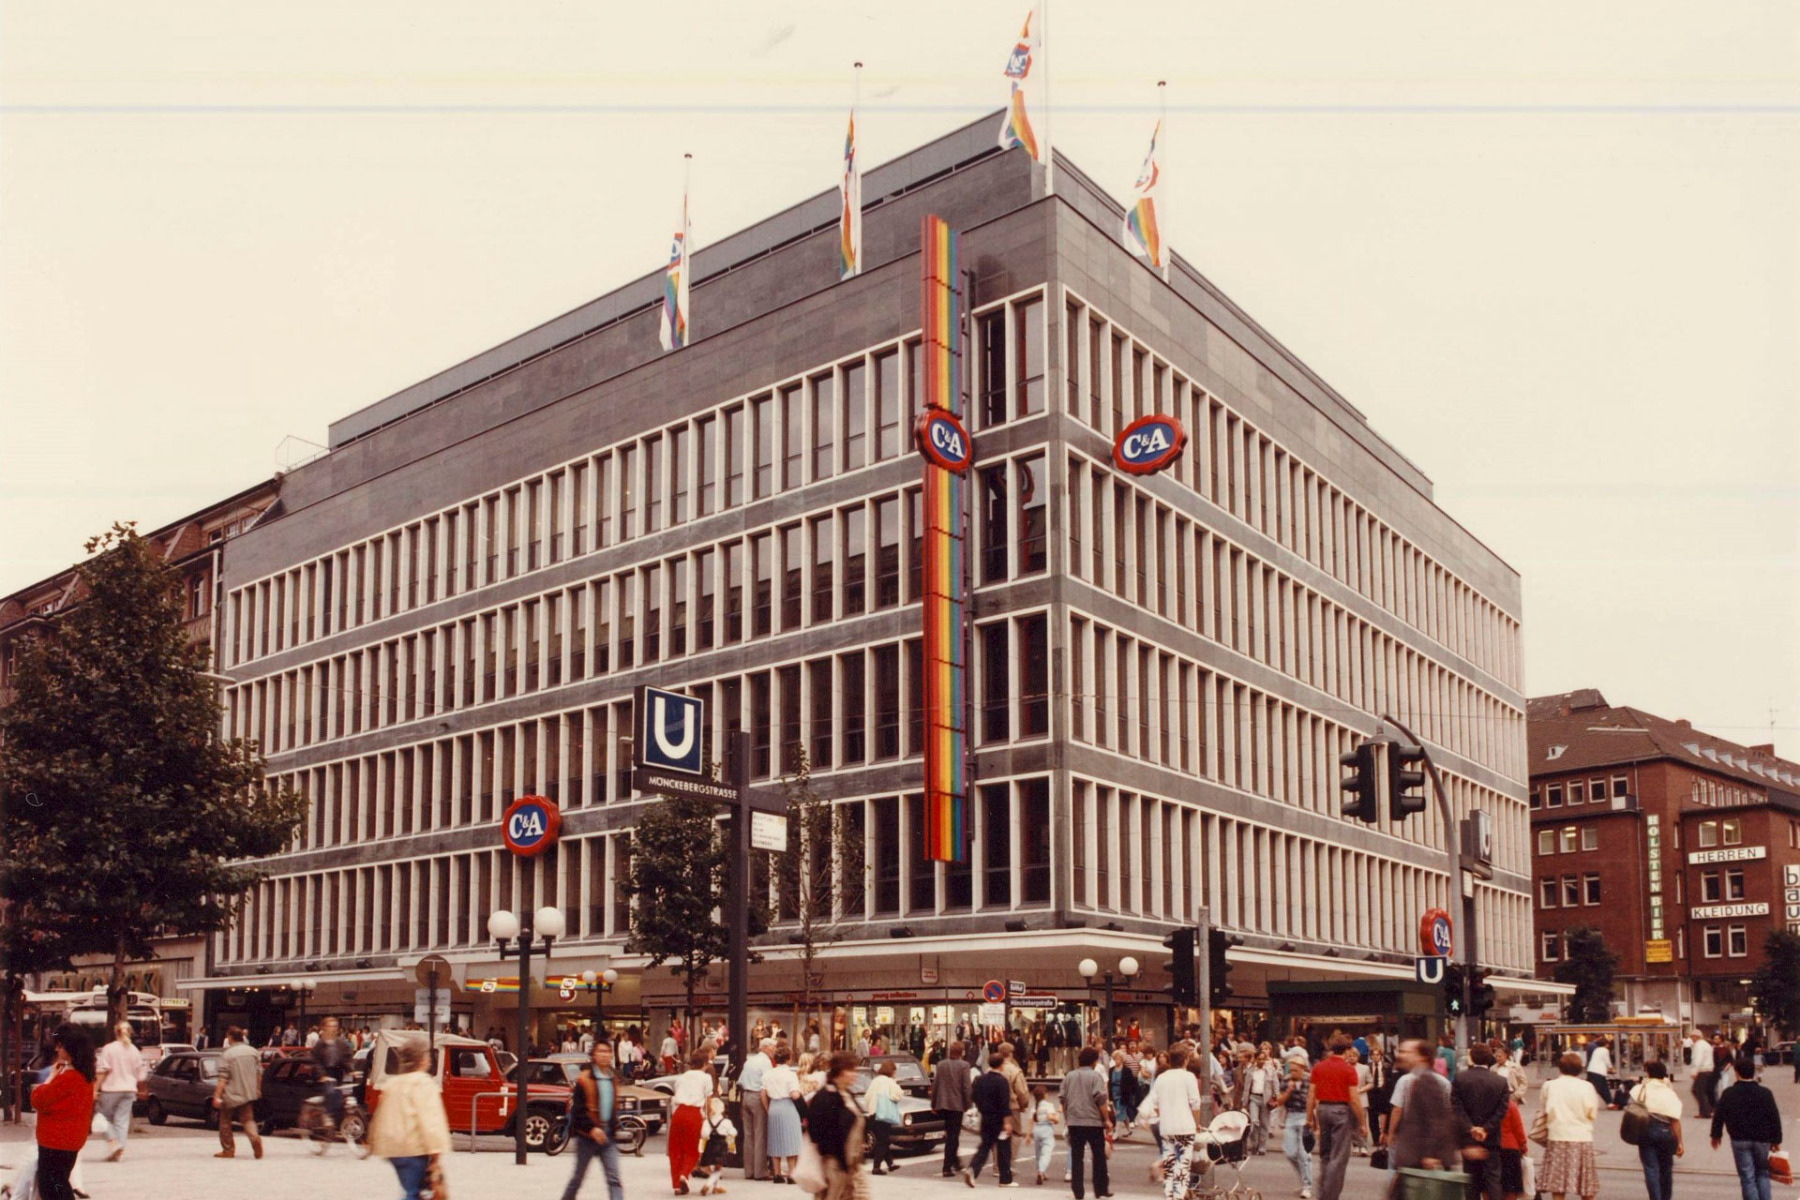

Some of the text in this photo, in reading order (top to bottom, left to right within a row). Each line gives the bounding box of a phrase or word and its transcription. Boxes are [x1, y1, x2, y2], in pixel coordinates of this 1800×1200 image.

[931, 423, 965, 460] C&A
[1123, 428, 1170, 459] C&A
[654, 696, 694, 759] U
[648, 776, 738, 800] MÖNCKEBERGSTRASSE
[509, 811, 544, 839] C&A
[1697, 848, 1756, 862] HERREN
[1651, 896, 1664, 940] BIER
[1694, 903, 1766, 918] KLEIDUNG
[1433, 923, 1451, 949] C&A
[1420, 958, 1443, 984] U
